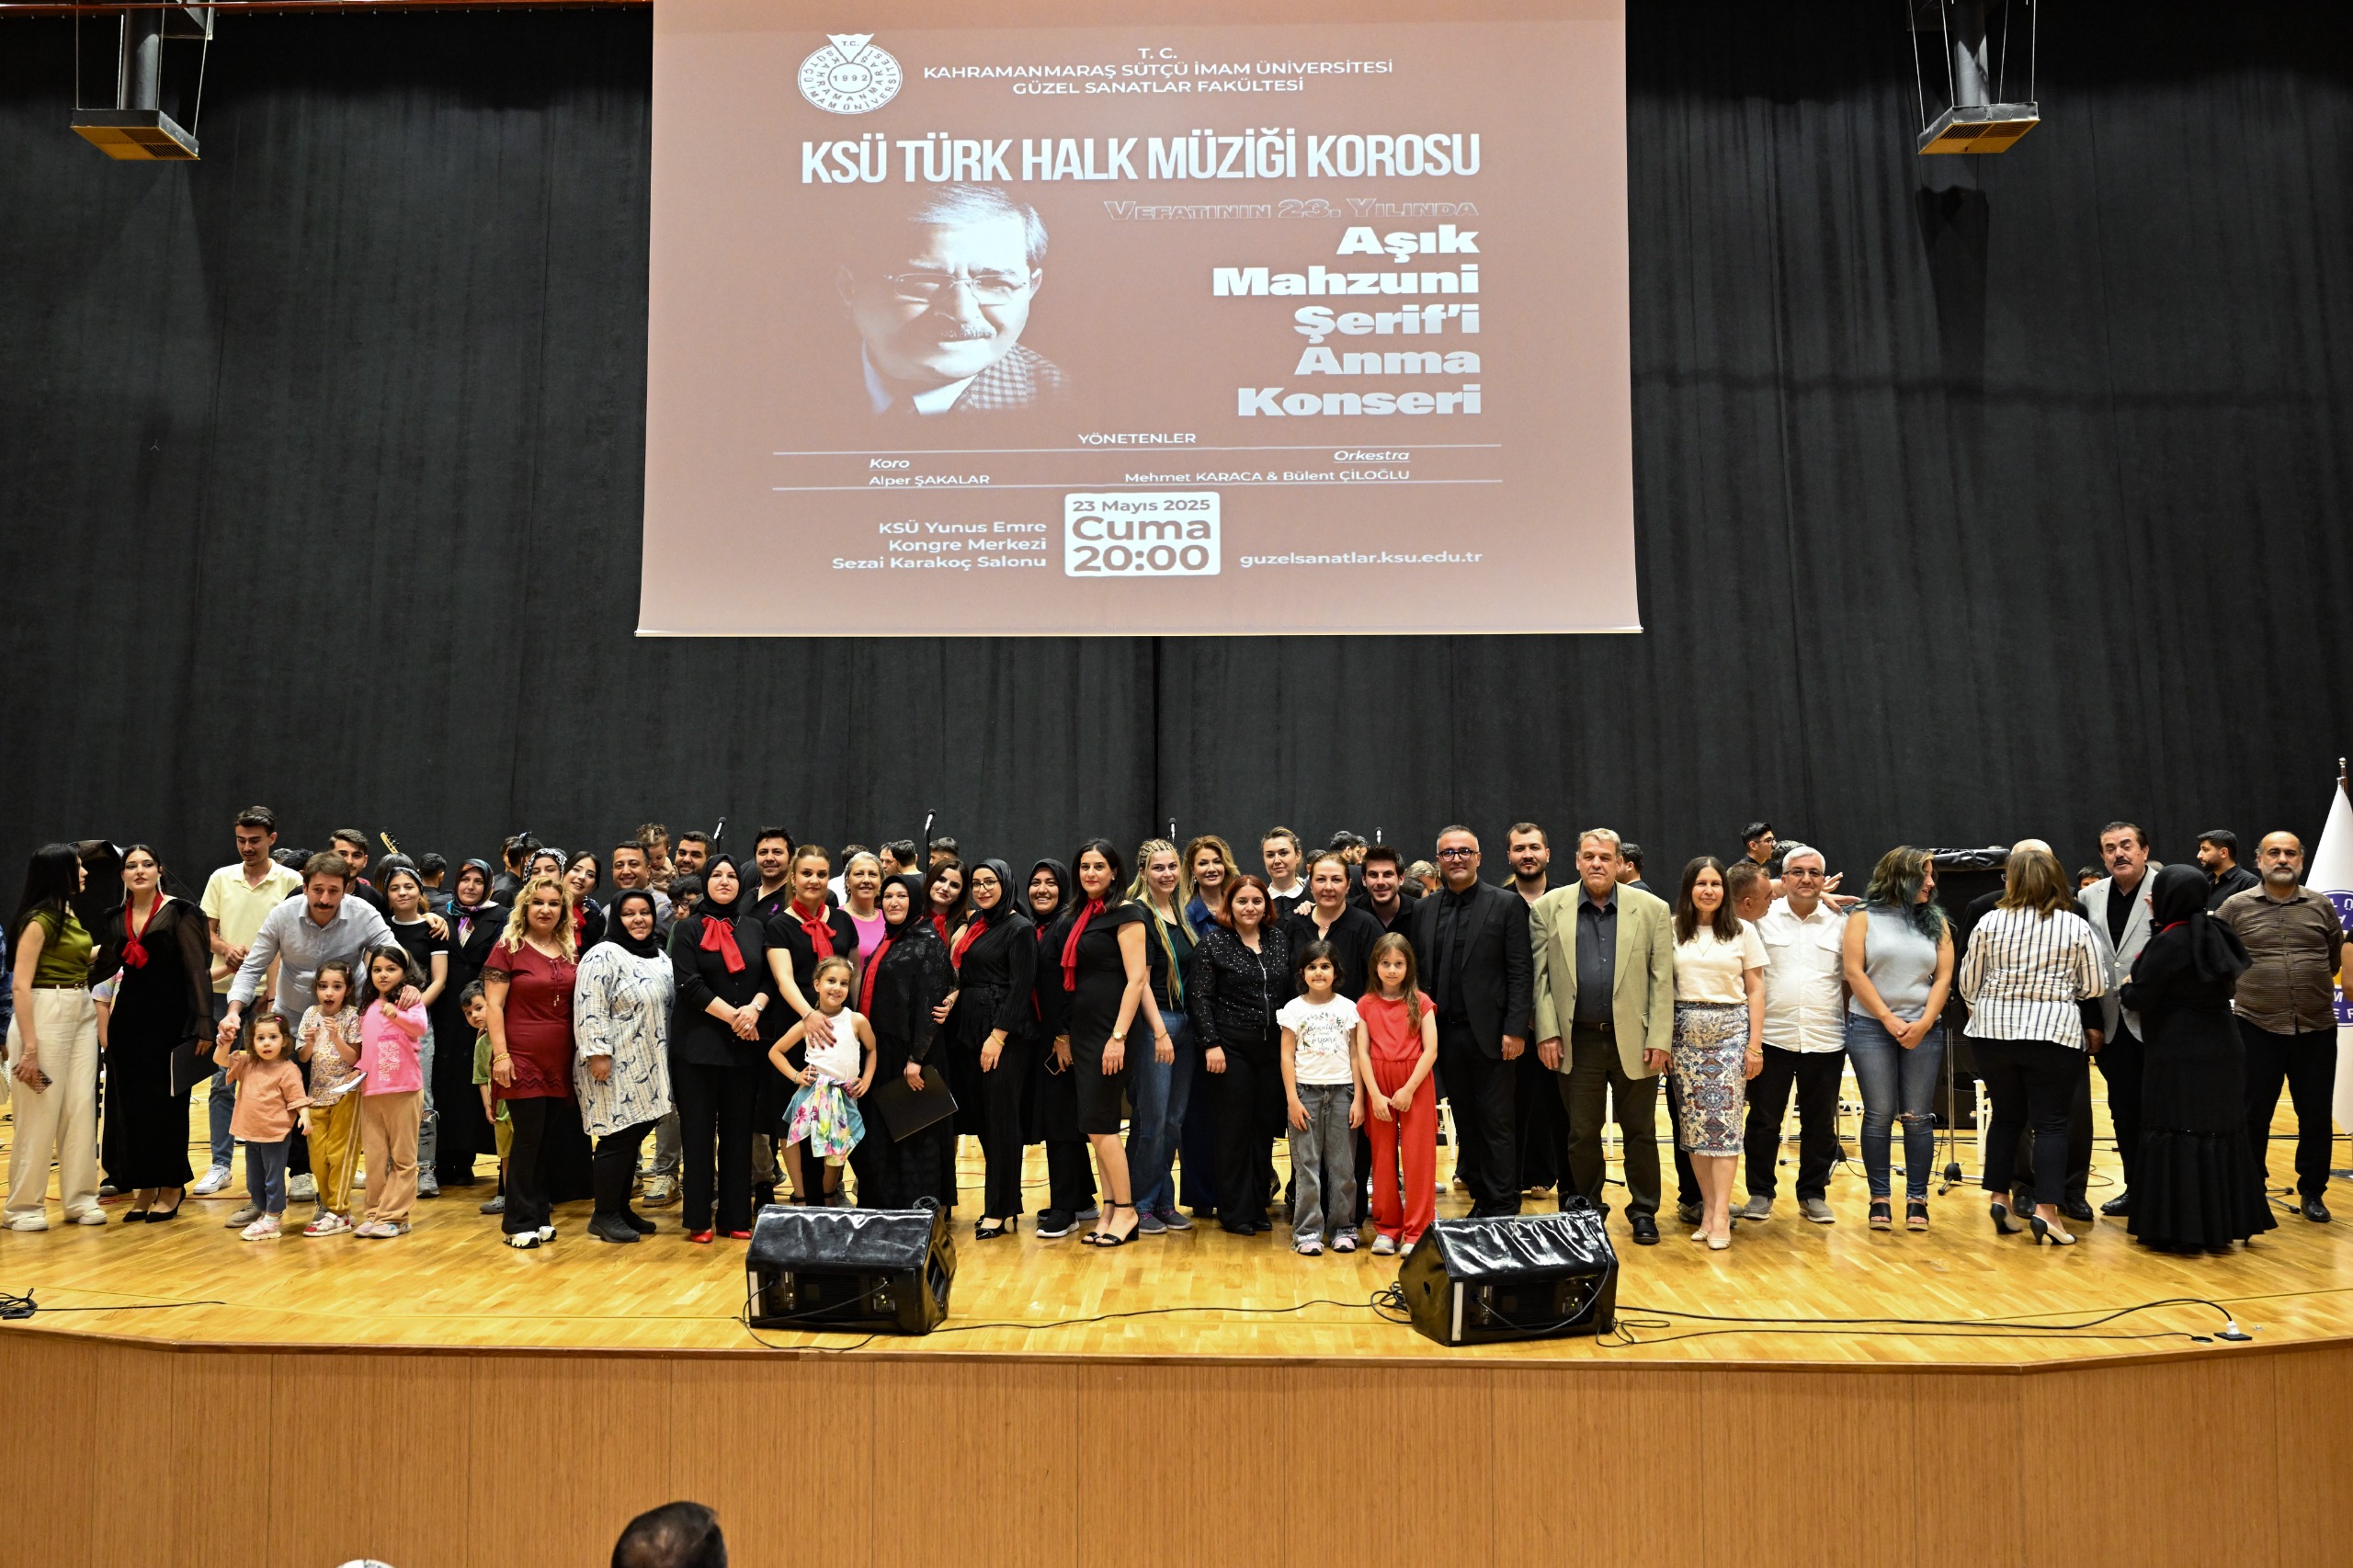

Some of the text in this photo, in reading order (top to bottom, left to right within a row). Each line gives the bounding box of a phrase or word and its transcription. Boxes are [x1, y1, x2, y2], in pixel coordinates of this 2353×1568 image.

[924, 59, 1393, 80] KAHRAMANMARAŞ SÜTÇÜ İMAM ÜNİVERSİTESİ
[1012, 76, 1304, 95] GÜZEL SANATLAR FAKÜLTESİ
[801, 127, 1481, 184] KSÜ TÜRK HALK MÜZİĞİ KOROSU
[1336, 224, 1481, 264] Aşık
[1212, 264, 1479, 296] Mahzuni
[1293, 303, 1480, 344] Şerif'i
[1294, 347, 1481, 375] Anma
[1237, 384, 1482, 416] Konseri
[1077, 432, 1197, 446] YÖNETENLER
[870, 458, 911, 469] Koro
[1334, 449, 1410, 461] Orkestra
[870, 474, 991, 487] Alper ŞAKALAR
[1125, 468, 1410, 483] Mehmet KARACA & Bülent ÇİLOĞLU
[1073, 499, 1211, 515] 23 Mayıs 2025
[879, 519, 1048, 534] KSÜ Yunus Emre
[1072, 515, 1212, 542] Cuma
[889, 537, 1047, 554] Kongre Merkezi
[832, 554, 1047, 572] Sezai Karakoç Salonu
[1073, 544, 1211, 573] 20:00
[1239, 551, 1483, 568] guzelsanatlar.ksu.edu.tr
